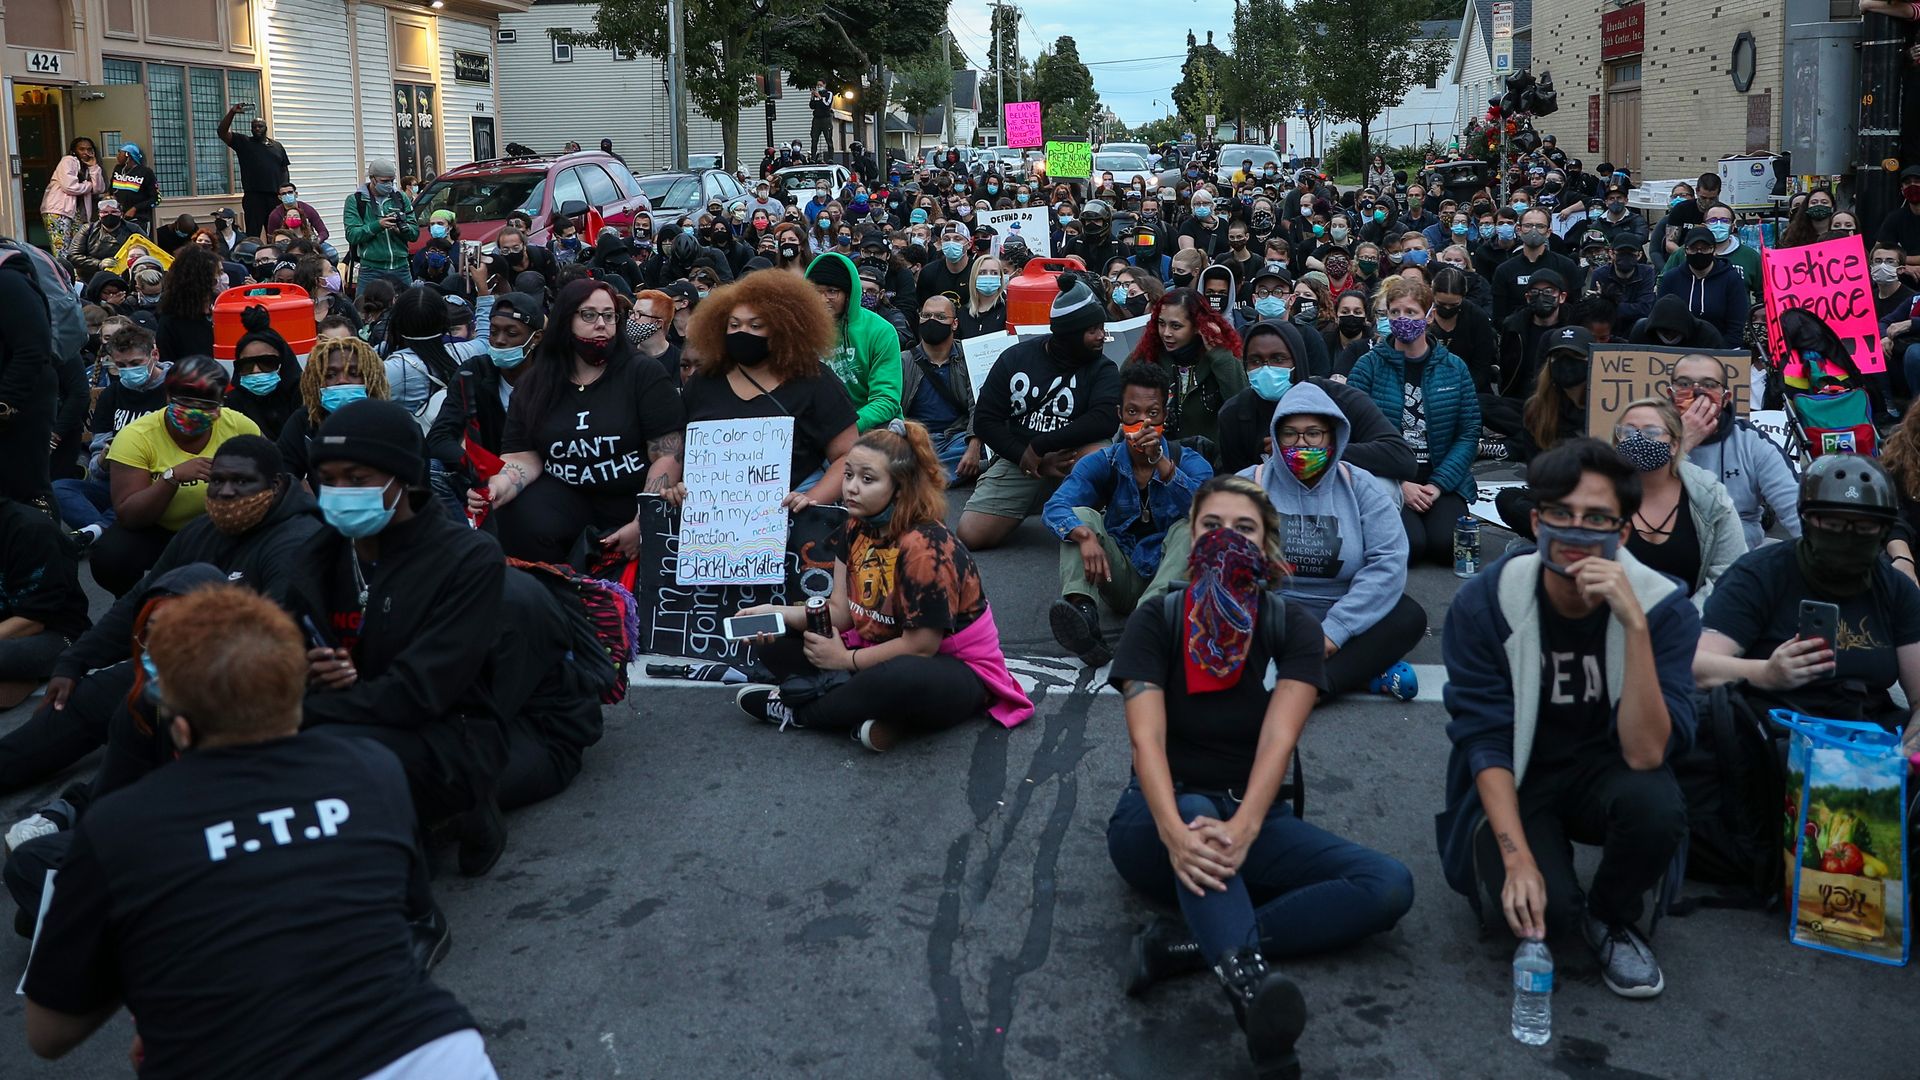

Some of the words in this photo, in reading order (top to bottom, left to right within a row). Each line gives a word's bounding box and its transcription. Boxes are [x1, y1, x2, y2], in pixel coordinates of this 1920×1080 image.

[1606, 19, 1628, 33] Abundant
[1628, 15, 1638, 27] Life
[1602, 36, 1614, 48] Faith
[1632, 30, 1643, 41] Inc.
[32, 53, 59, 72] 424
[1016, 103, 1038, 111] CAN'T
[1862, 94, 1873, 106] 49
[1010, 111, 1038, 119] BELIEVE
[1048, 149, 1091, 162] PRETENDING
[1054, 142, 1083, 153] STOP
[113, 171, 144, 184] Polaroid
[990, 212, 1019, 224] DEFUND
[1021, 212, 1033, 221] DA
[1600, 356, 1635, 373] WE
[1649, 356, 1739, 379] DED
[1601, 379, 1750, 416] JUSE
[575, 411, 590, 430] I
[687, 426, 709, 446] The
[712, 428, 748, 444] Color
[753, 421, 771, 441] of
[772, 428, 790, 450] my
[550, 436, 621, 459] CAN'T
[721, 448, 765, 462] should
[686, 469, 707, 484] not
[711, 469, 731, 486] put
[735, 471, 744, 482] a
[748, 464, 780, 484] KNEE
[699, 489, 718, 508] my
[721, 489, 753, 502] neck
[758, 490, 772, 502] or
[774, 487, 784, 502] a
[682, 506, 710, 525] Gun
[713, 505, 724, 521] in
[728, 507, 751, 527] my
[681, 528, 740, 545] Direction.
[1286, 537, 1324, 546] AFRICAN
[1284, 555, 1323, 565] HISTORY
[1285, 547, 1332, 556] AMERICAN
[204, 798, 350, 862] F.T.P
